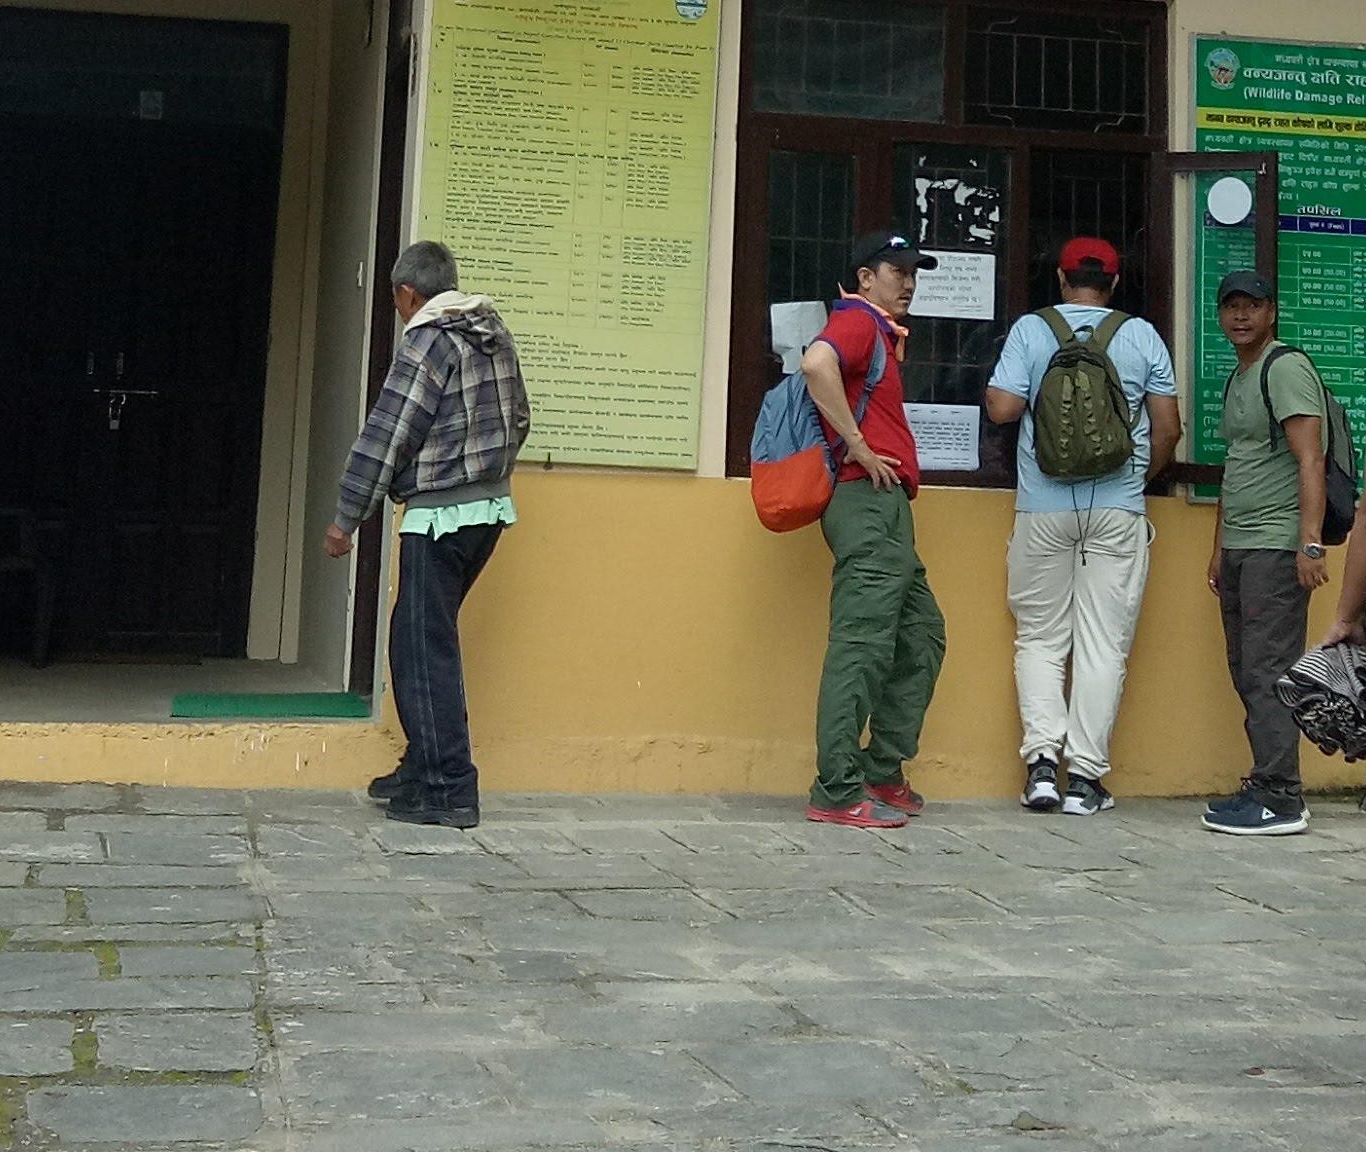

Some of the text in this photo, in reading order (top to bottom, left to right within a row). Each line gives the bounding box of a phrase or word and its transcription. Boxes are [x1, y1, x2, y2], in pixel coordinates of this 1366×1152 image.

[1243, 67, 1307, 86] वन्यजन्तु
[1310, 69, 1341, 86] क्षति
[1243, 86, 1292, 101] (Wildlife
[1295, 90, 1343, 106] Damage
[1297, 203, 1342, 216] तपसिल
